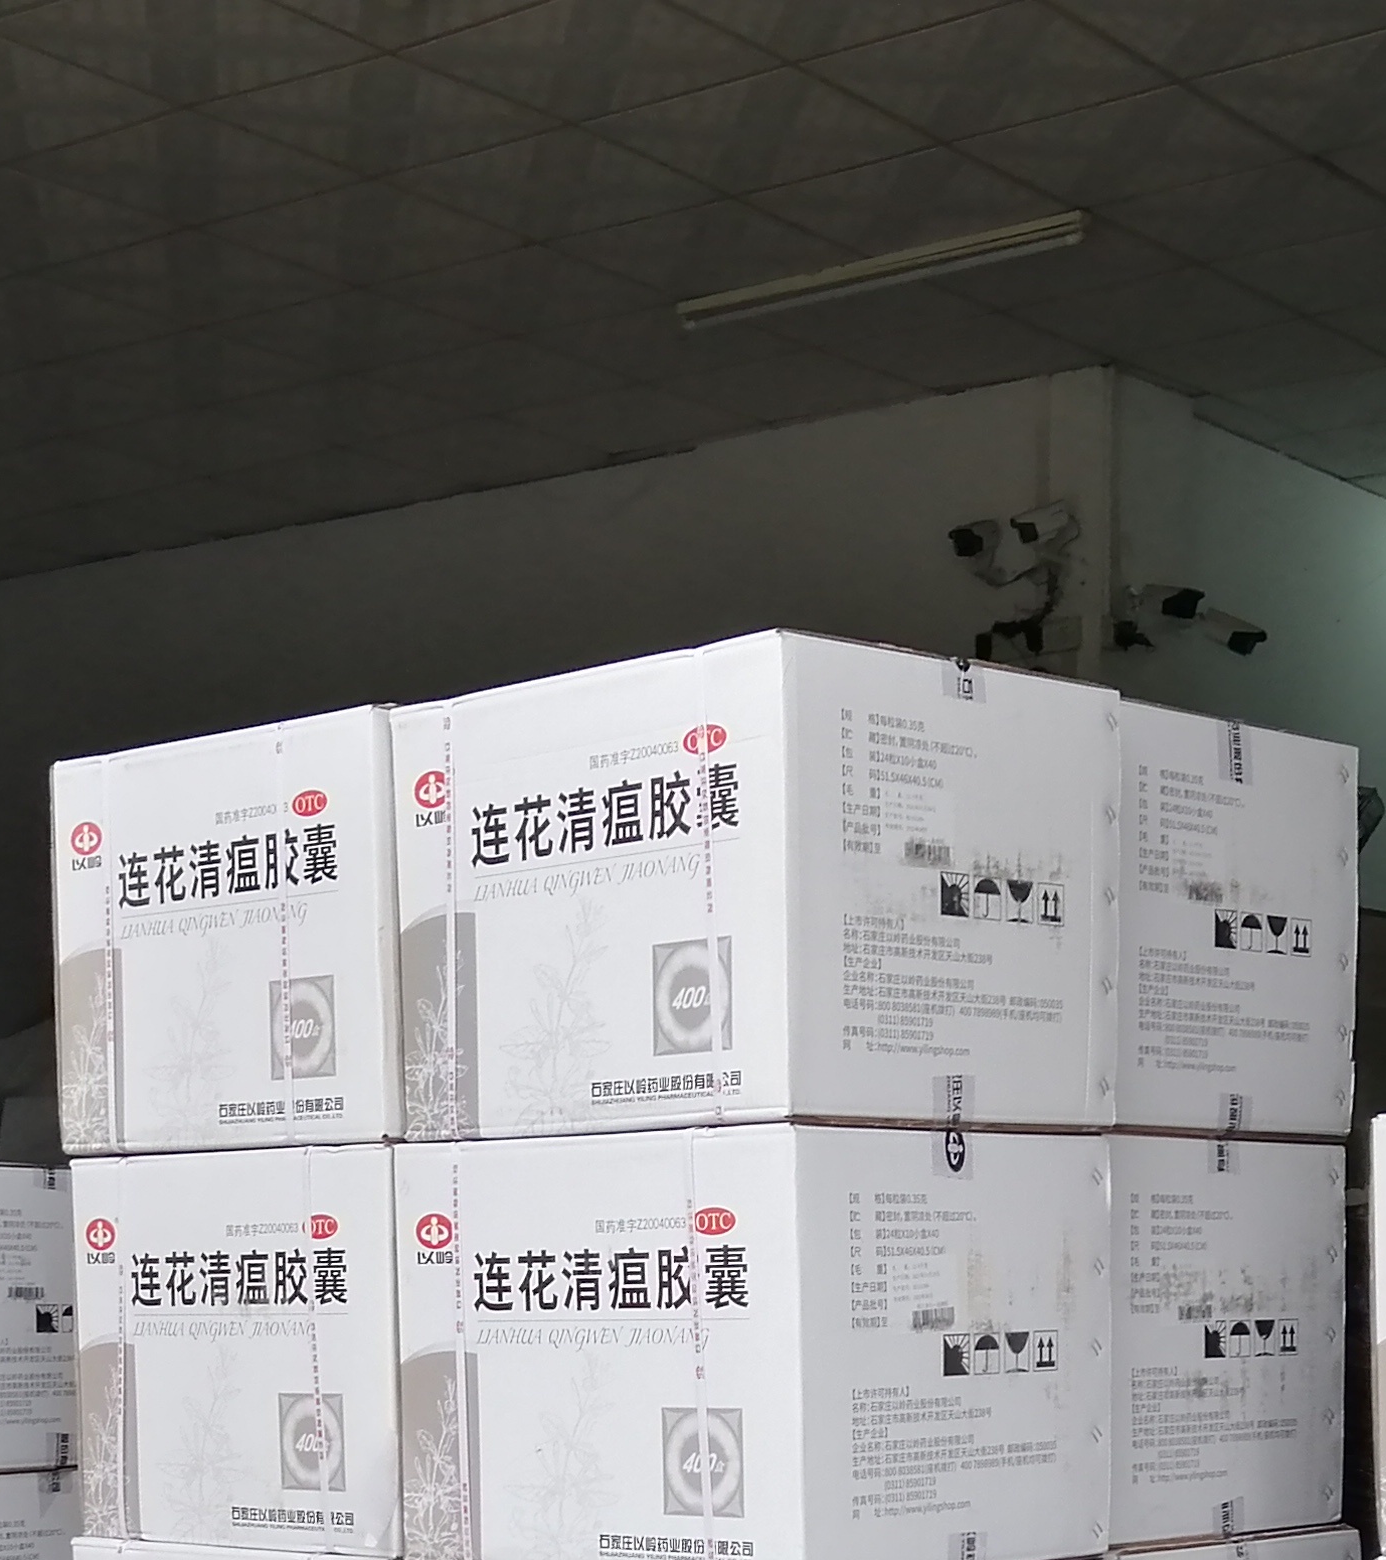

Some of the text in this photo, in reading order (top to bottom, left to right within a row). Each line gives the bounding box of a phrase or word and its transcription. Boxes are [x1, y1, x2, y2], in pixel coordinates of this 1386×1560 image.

[589, 738, 679, 770] 国药准字Z20040063
[215, 800, 289, 826] 国药准字Z200403
[293, 792, 324, 815] OTC
[471, 763, 739, 867] 连花清瘟胶囊
[71, 855, 102, 871] 以岭
[118, 824, 338, 907] 连花清瘟胶囊
[473, 852, 700, 903] LIANHUA QINGWEN JIAONANG
[119, 901, 307, 940] LIANHUA QINGWEN JIAONNG
[219, 1095, 343, 1120] 石家庄以岭药业份有限公司
[224, 1221, 297, 1238] 国药准字Z20040063
[594, 1215, 687, 1234] 国药准字Z20040063
[693, 1211, 732, 1232] OTC
[86, 1252, 115, 1265] 以岭
[416, 1251, 453, 1265] 以岭
[131, 1247, 348, 1307] 连花清瘟胶囊
[474, 1244, 749, 1312] 连花清瘟胶囊
[132, 1320, 184, 1335] LIANHUA
[188, 1320, 249, 1342] QINGWEN
[475, 1328, 542, 1345] LIANHUA
[547, 1327, 624, 1351] QINGWEN
[598, 1534, 754, 1557] 石家庄以岭药业股份限公司
